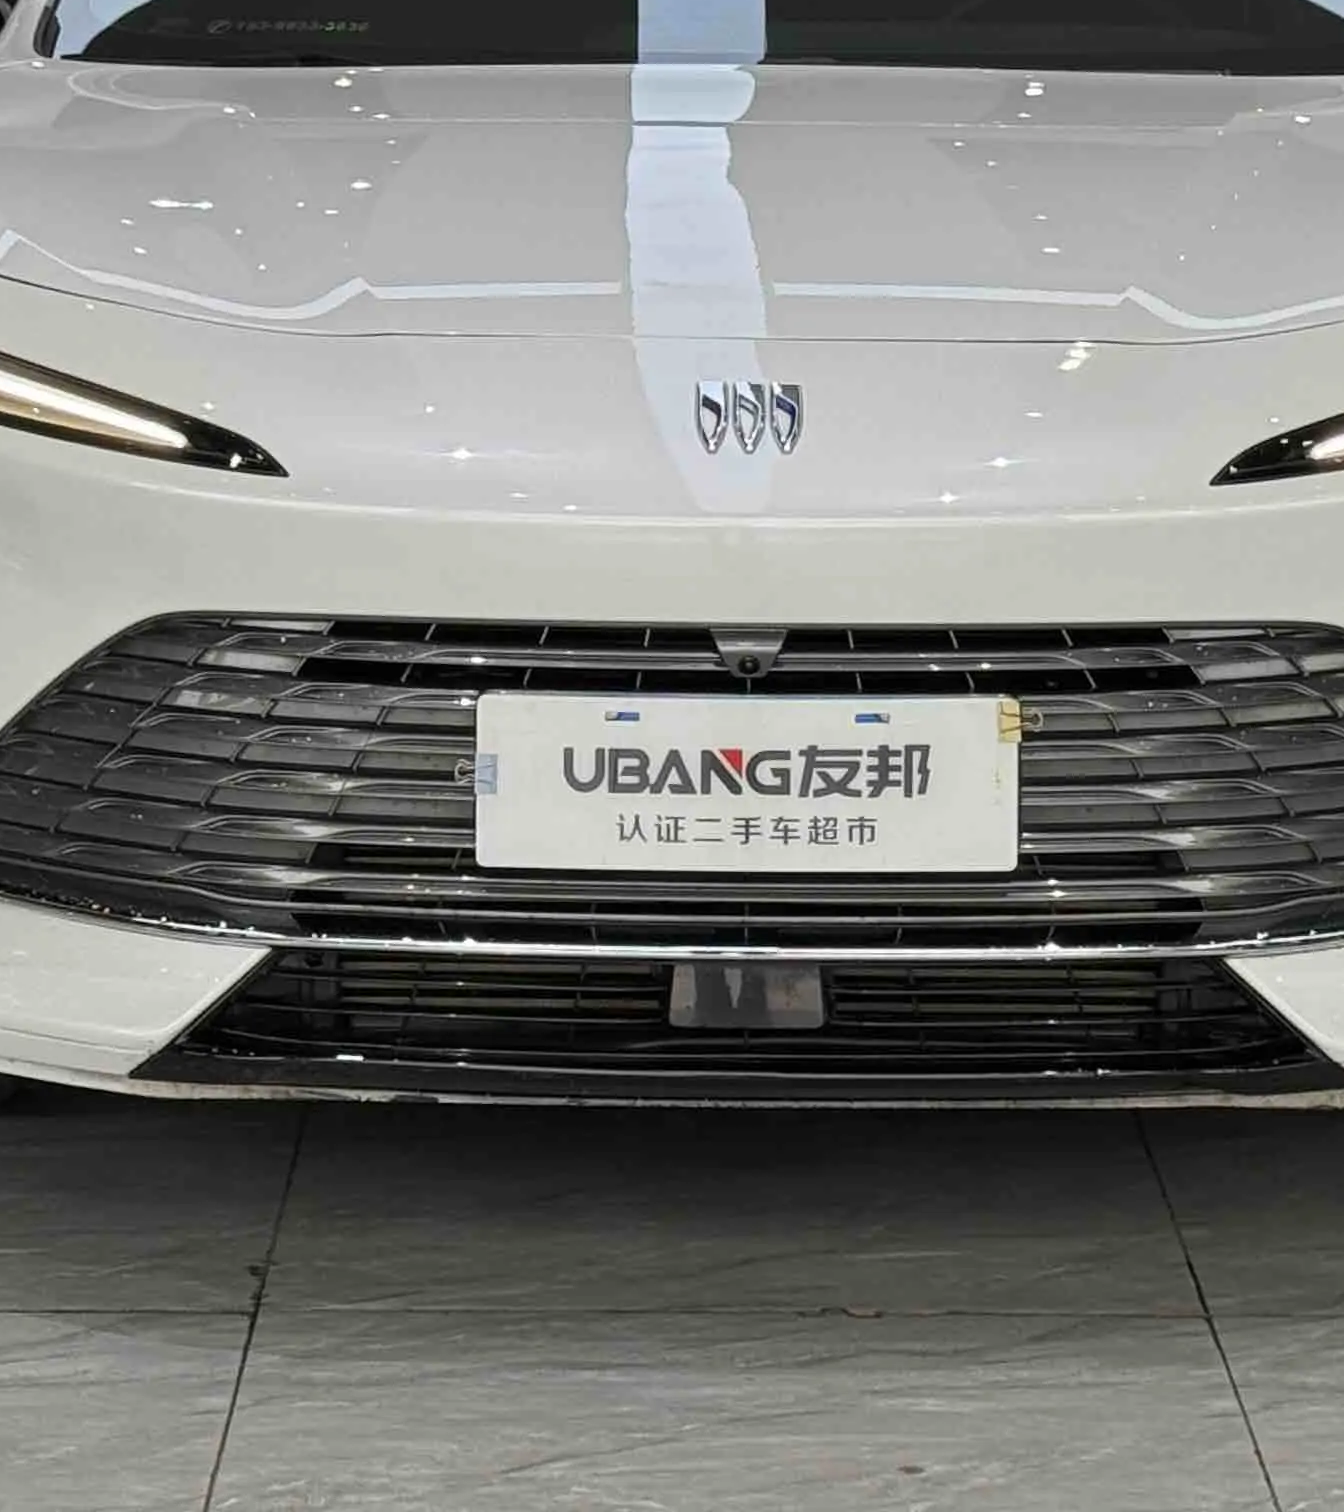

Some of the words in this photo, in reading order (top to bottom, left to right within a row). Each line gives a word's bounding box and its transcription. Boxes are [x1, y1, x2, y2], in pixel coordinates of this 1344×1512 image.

[563, 744, 932, 799] UBANG友邦
[616, 813, 878, 846] 认证二手车超市
